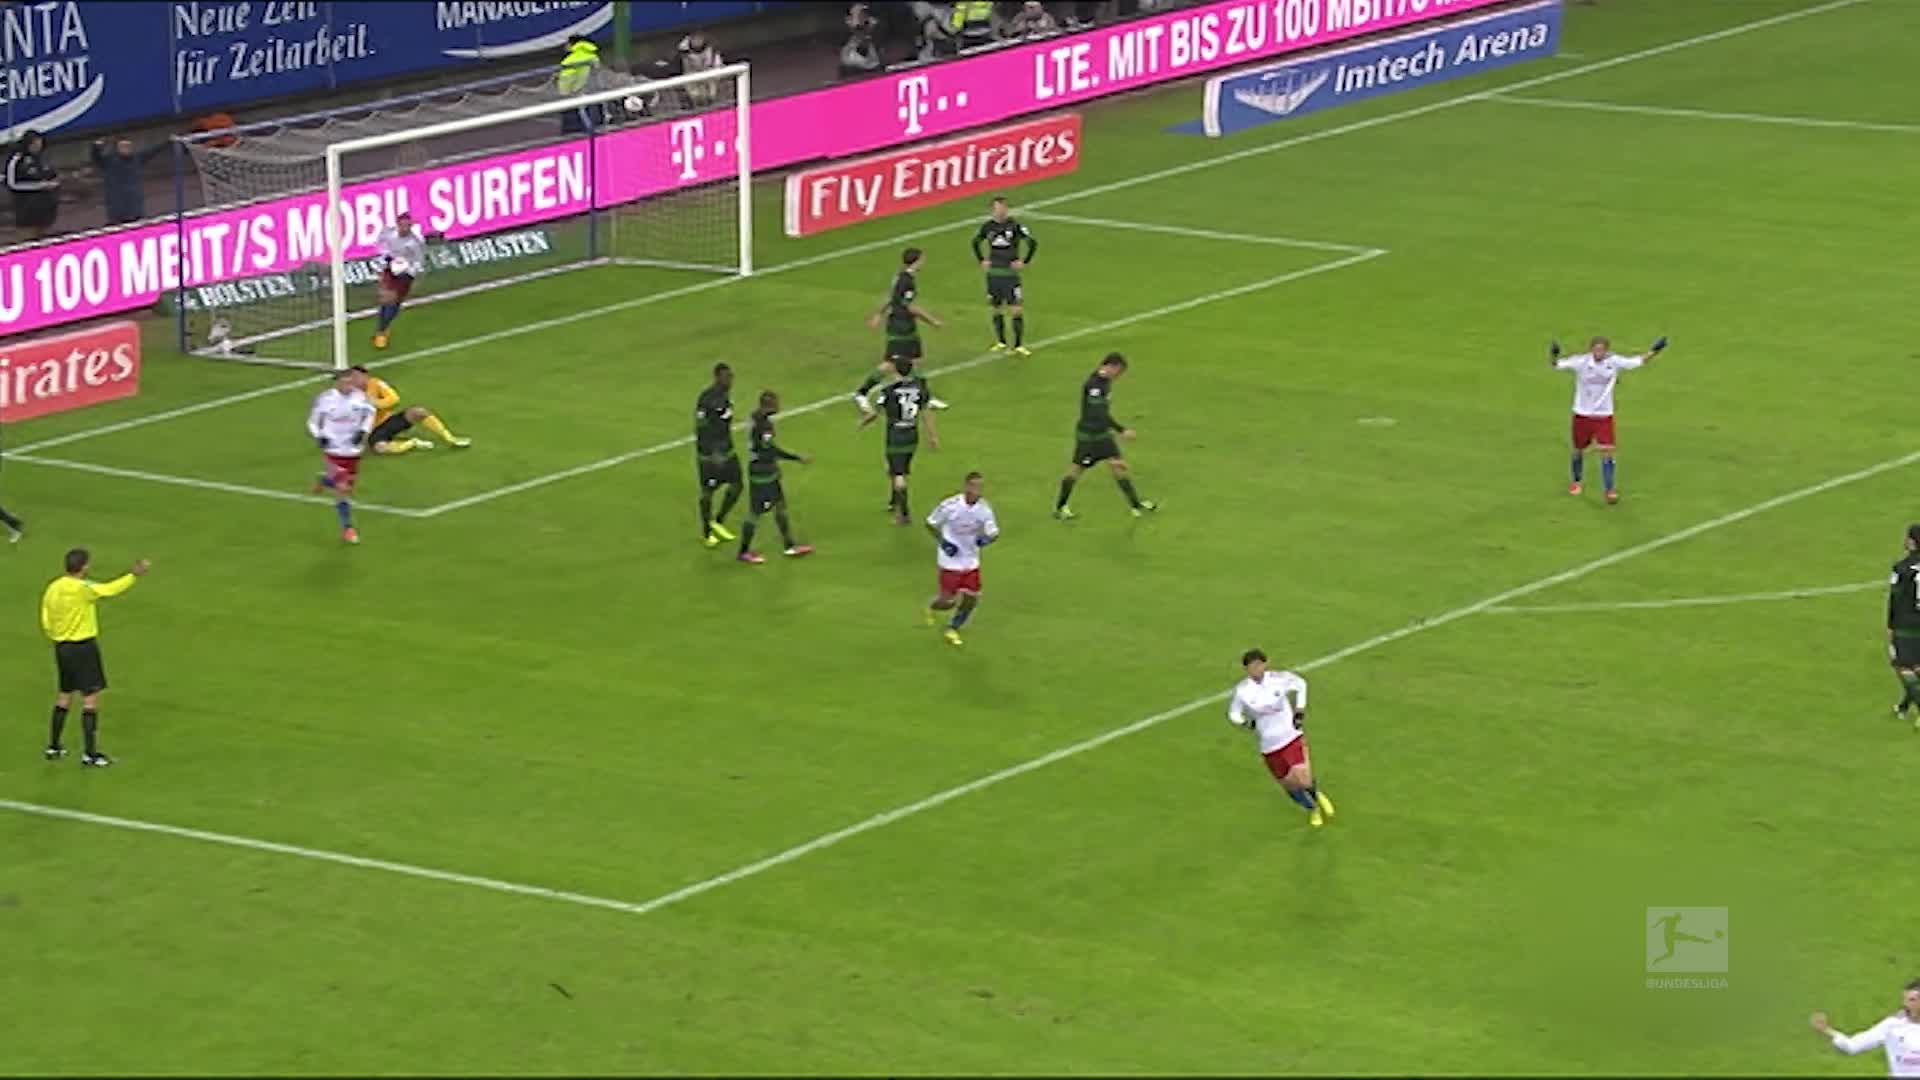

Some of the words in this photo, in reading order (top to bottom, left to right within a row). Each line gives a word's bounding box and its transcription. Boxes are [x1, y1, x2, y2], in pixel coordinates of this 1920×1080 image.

[0, 2, 87, 62] NTA
[175, 2, 250, 39] Neue
[1035, 43, 1099, 99] LTE.
[1108, 26, 1163, 80] MIT
[1169, 12, 1220, 67] BIS
[1226, 4, 1266, 54] ZU
[1274, 0, 1319, 43] 100
[176, 50, 220, 95] für
[229, 24, 376, 80] Zeitarbeit.
[1334, 41, 1445, 93] Imtech
[1452, 23, 1549, 66] Arena
[811, 174, 883, 217] Fly
[893, 129, 1075, 199] Emirates
[35, 248, 109, 313] 100
[119, 214, 277, 297] MBIT/S
[287, 186, 424, 261] MOBIL
[458, 230, 550, 266] HOLSTEN
[198, 271, 295, 306] HOLSTEN
[0, 343, 134, 409] irates
